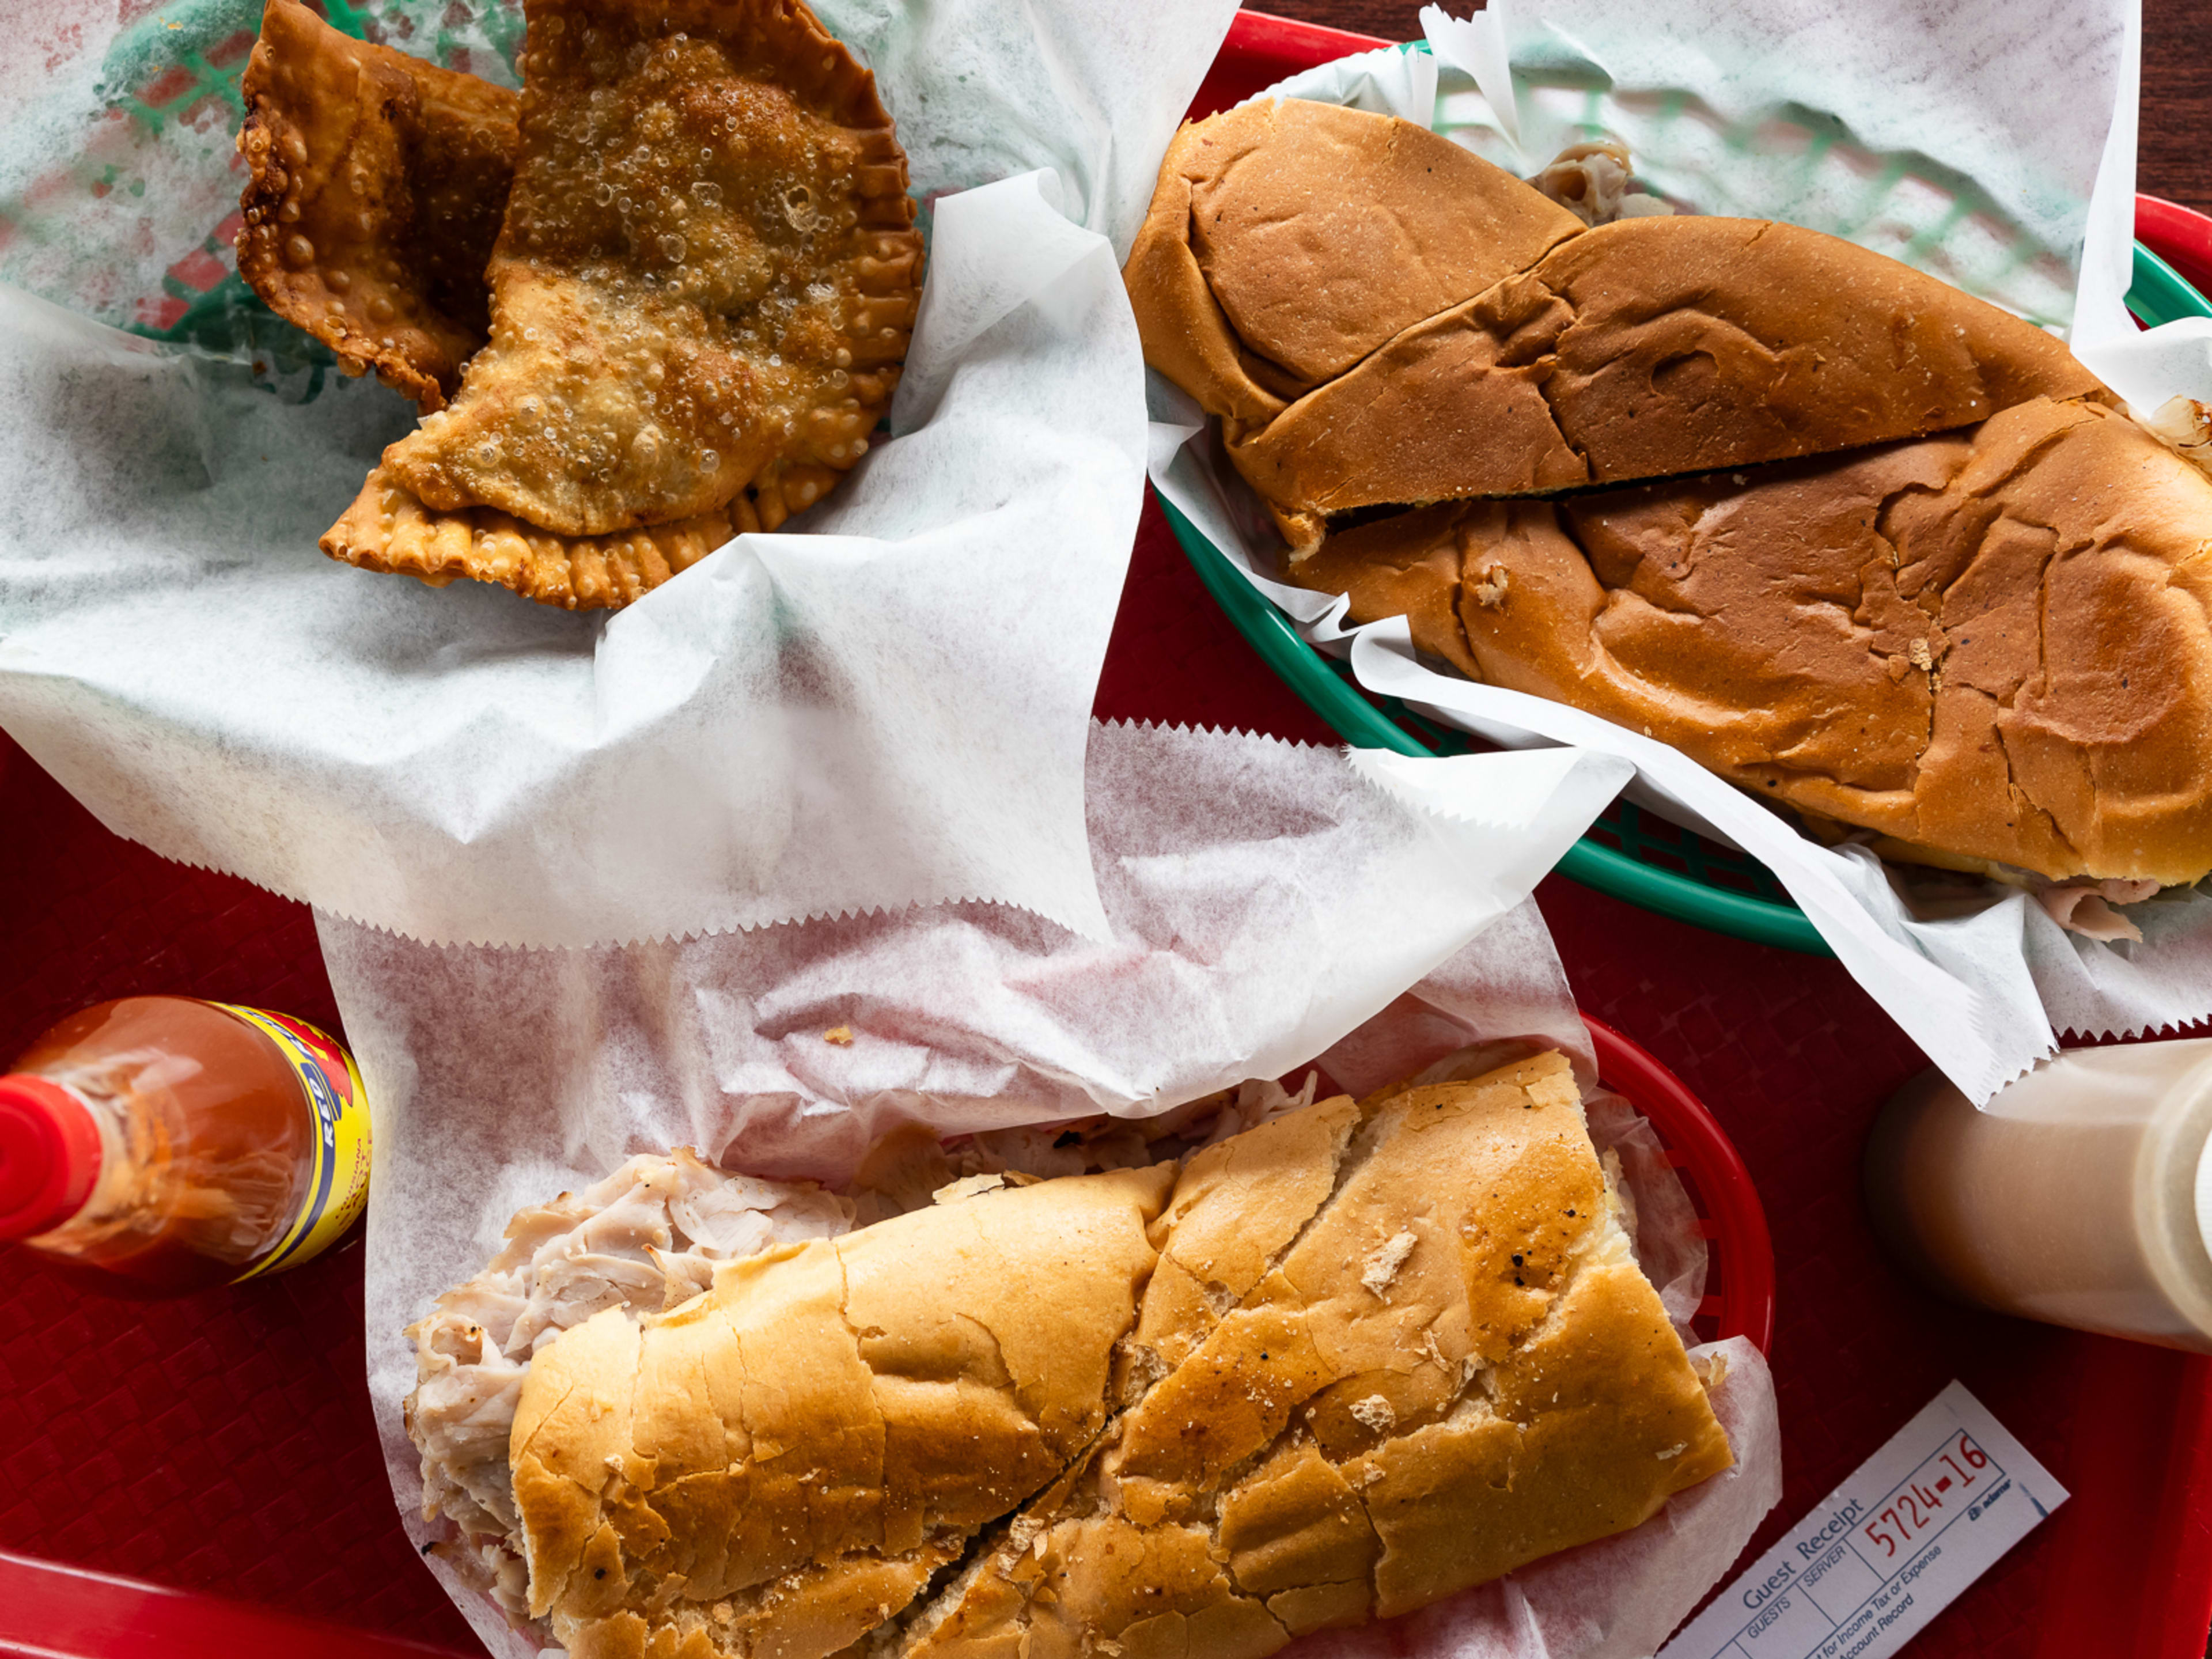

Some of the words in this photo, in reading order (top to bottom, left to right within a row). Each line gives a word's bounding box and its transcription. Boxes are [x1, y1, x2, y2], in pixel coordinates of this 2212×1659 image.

[309, 1077, 334, 1148] RED
[1865, 1435, 1987, 1558] 5724-16
[1743, 1560, 1796, 1609] Guest
[1796, 1498, 1864, 1560] Receipt
[1804, 1545, 1847, 1588] SERVER
[1748, 1597, 1791, 1639] GUESTS
[1823, 1641, 1838, 1658] for
[1836, 1609, 1873, 1645] Income
[1871, 1593, 1891, 1611] Tax
[1891, 1581, 1901, 1596] or
[1900, 1546, 1942, 1585] Expense
[1877, 1593, 1914, 1631] Record
